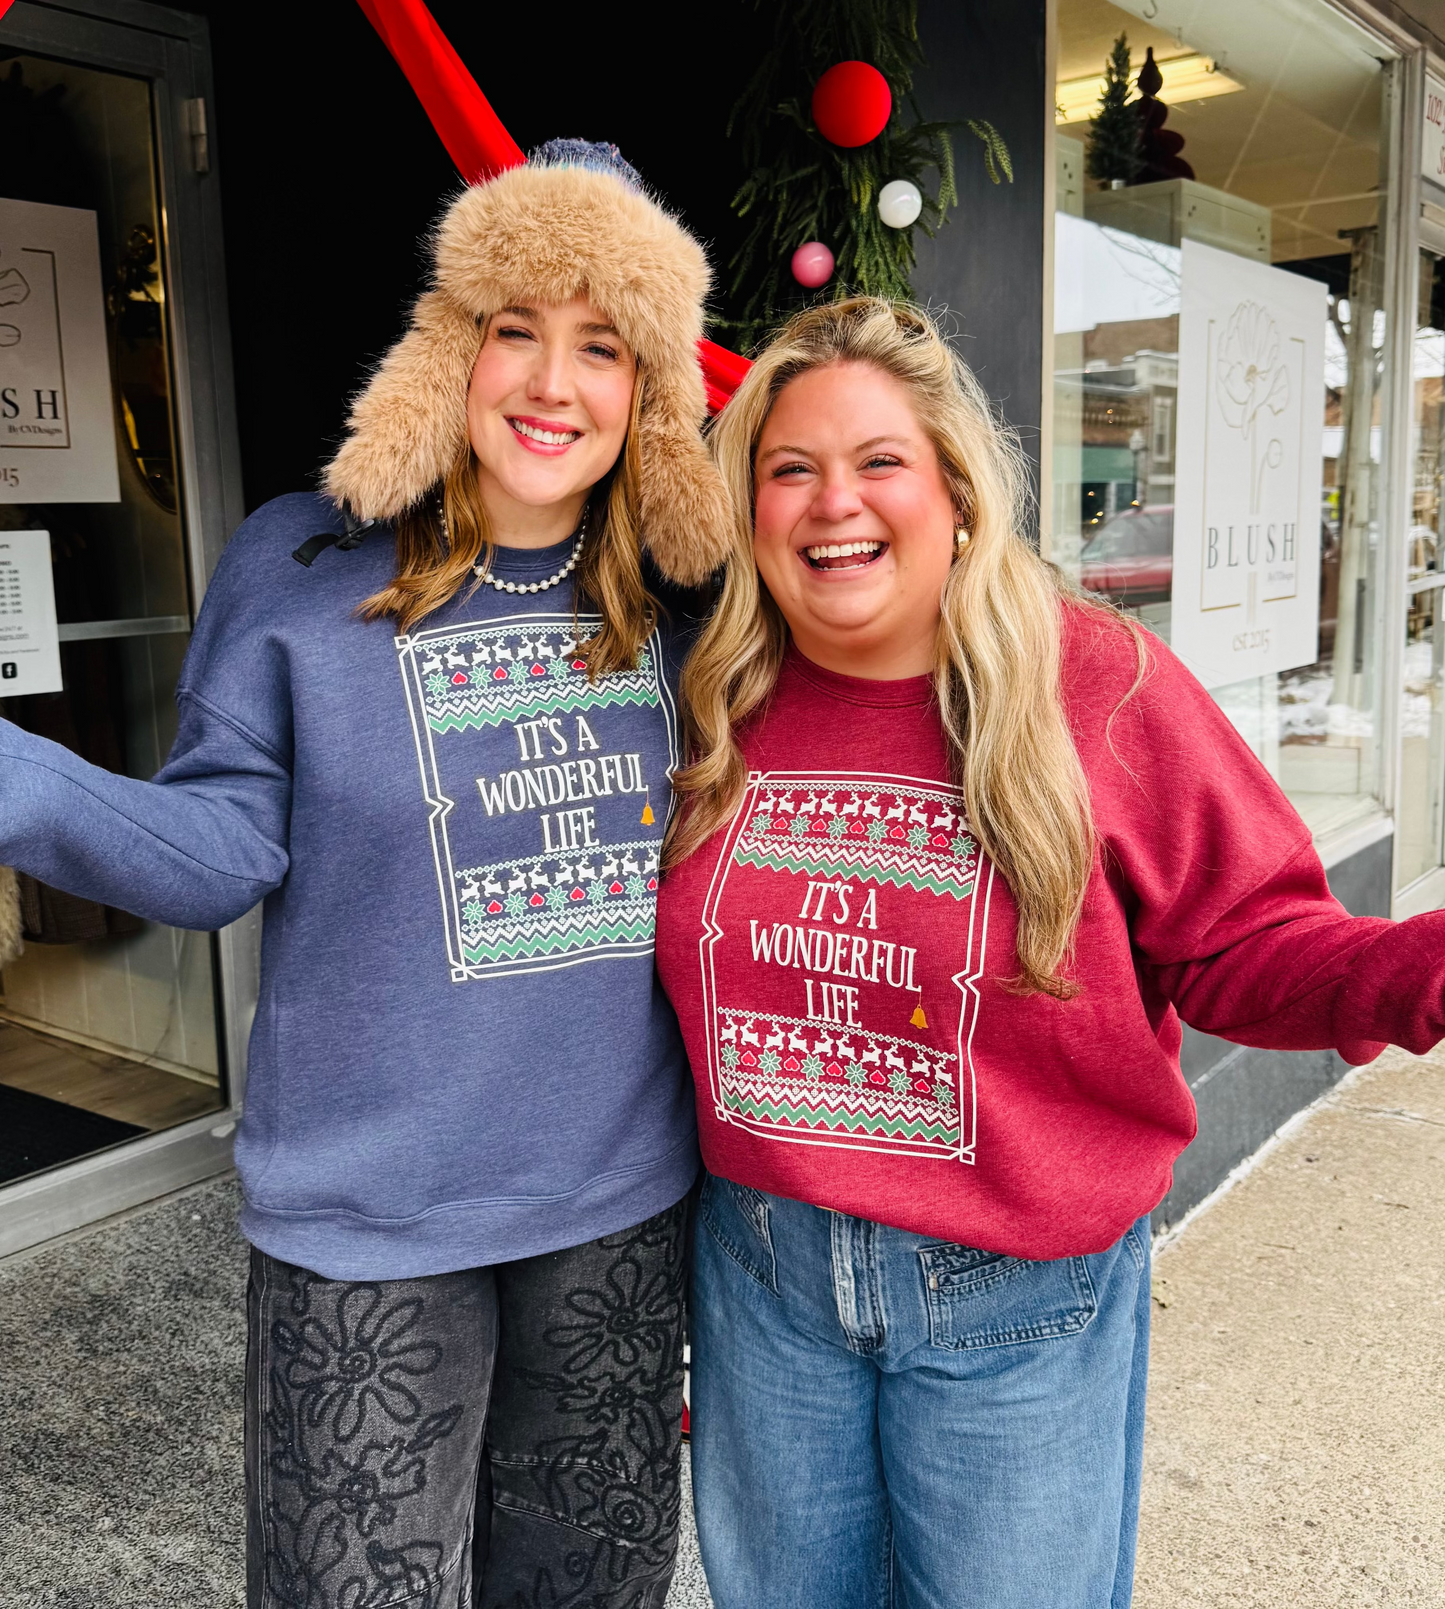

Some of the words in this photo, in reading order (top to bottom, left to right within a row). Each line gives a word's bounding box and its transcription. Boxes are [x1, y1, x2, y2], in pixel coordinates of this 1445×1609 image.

[1425, 94, 1442, 126] 102
[0, 467, 20, 488] 15
[1206, 523, 1296, 569] BLUSH
[575, 715, 599, 751] A
[475, 754, 649, 816] WONDERFUL
[540, 806, 600, 853] LIFE
[857, 889, 878, 930] A
[750, 920, 922, 992] WONDERFUL
[804, 979, 862, 1028] LIFE
